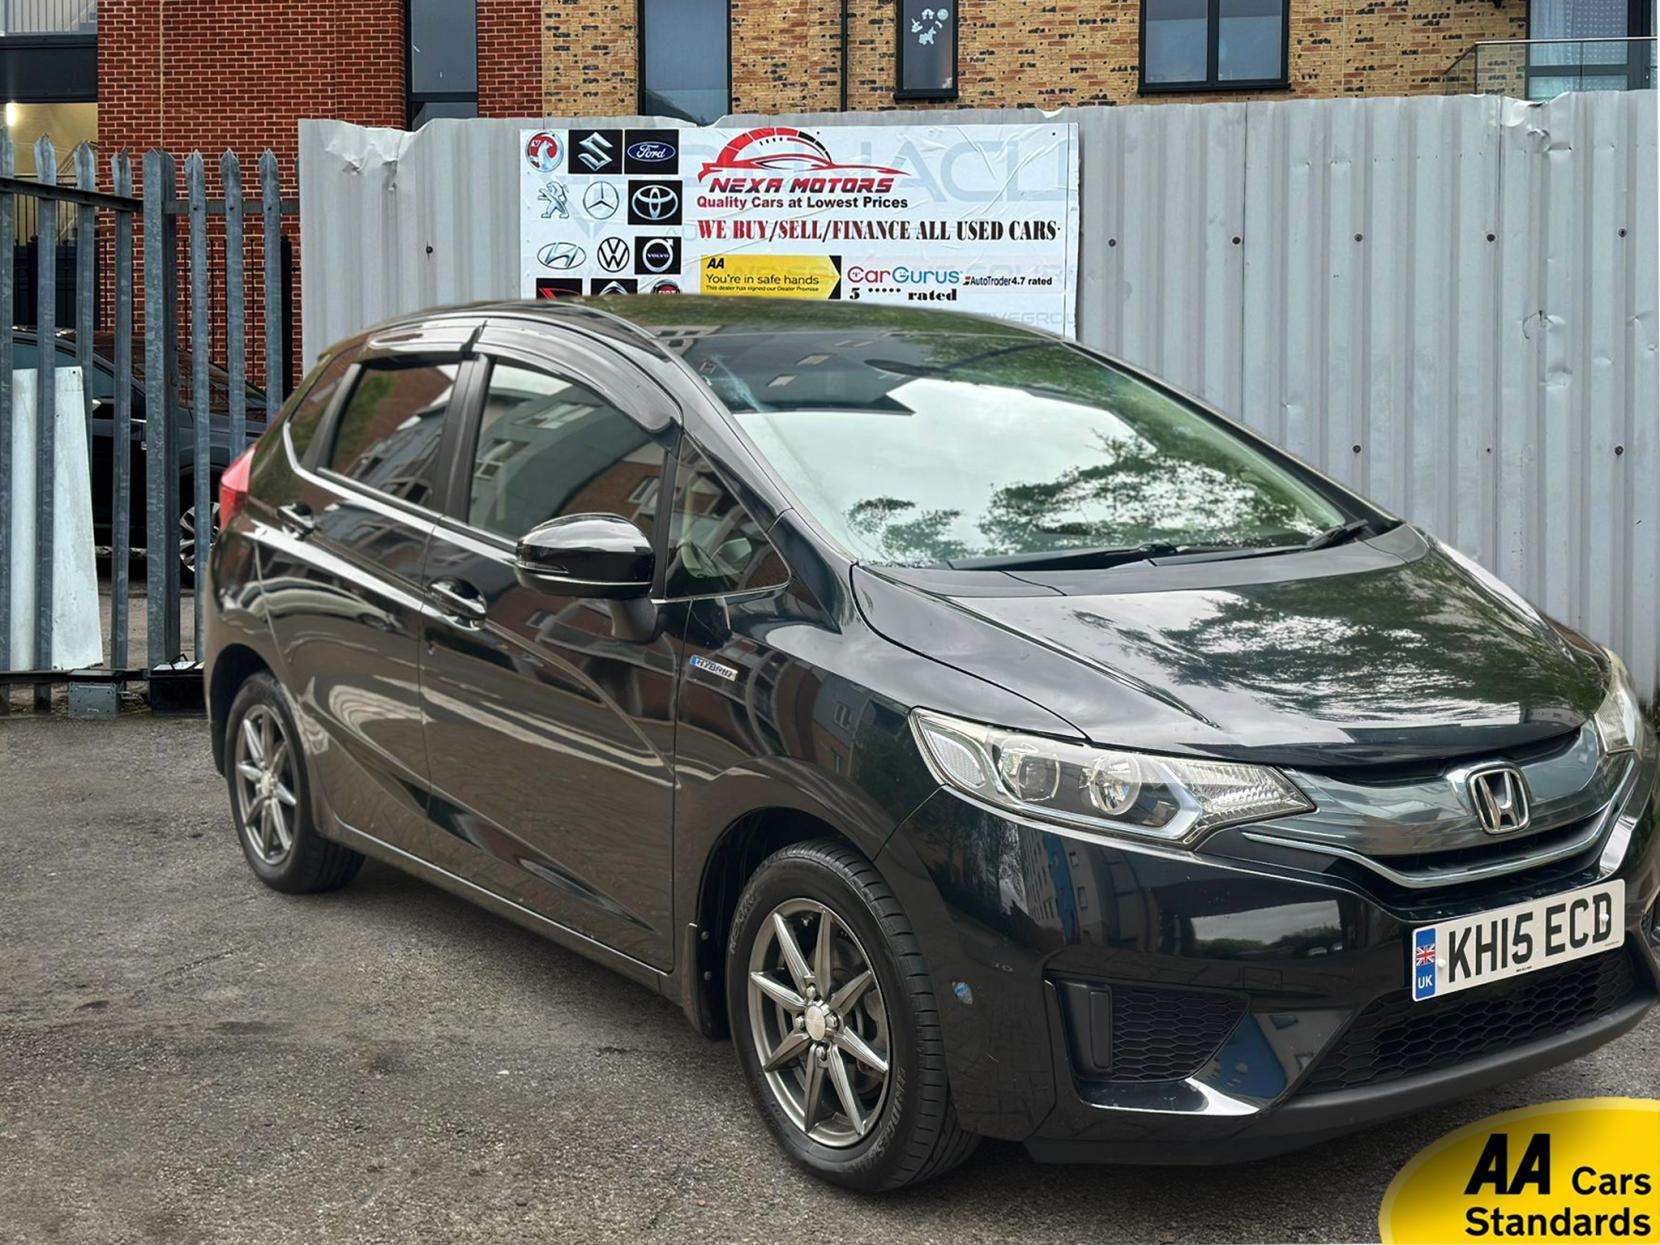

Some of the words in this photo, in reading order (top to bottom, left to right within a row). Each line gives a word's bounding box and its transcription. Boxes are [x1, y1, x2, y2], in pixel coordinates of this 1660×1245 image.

[636, 143, 667, 159] Ford
[709, 177, 784, 194] NEXA
[789, 177, 895, 194] MOTORS
[697, 196, 747, 211] Quality
[751, 196, 784, 209] Cars
[788, 196, 803, 208] at
[807, 196, 858, 208] Lowest
[863, 196, 909, 208] Prices
[696, 219, 727, 240] WE
[732, 219, 911, 242] BUY/SELL/FINANCE
[915, 219, 951, 240] ALL
[956, 219, 1004, 240] USED
[706, 257, 725, 269] AA
[706, 273, 741, 284] You're
[744, 274, 754, 284] in
[757, 274, 781, 284] safe
[784, 274, 820, 285] hands
[847, 266, 960, 284] CarGurus
[1027, 277, 1053, 286] rated
[849, 287, 861, 300] 5
[908, 288, 958, 301] rated
[694, 657, 733, 679] HYBRID
[1448, 911, 1534, 983] KH15
[1545, 892, 1612, 957] ECD
[1417, 974, 1433, 989] UK
